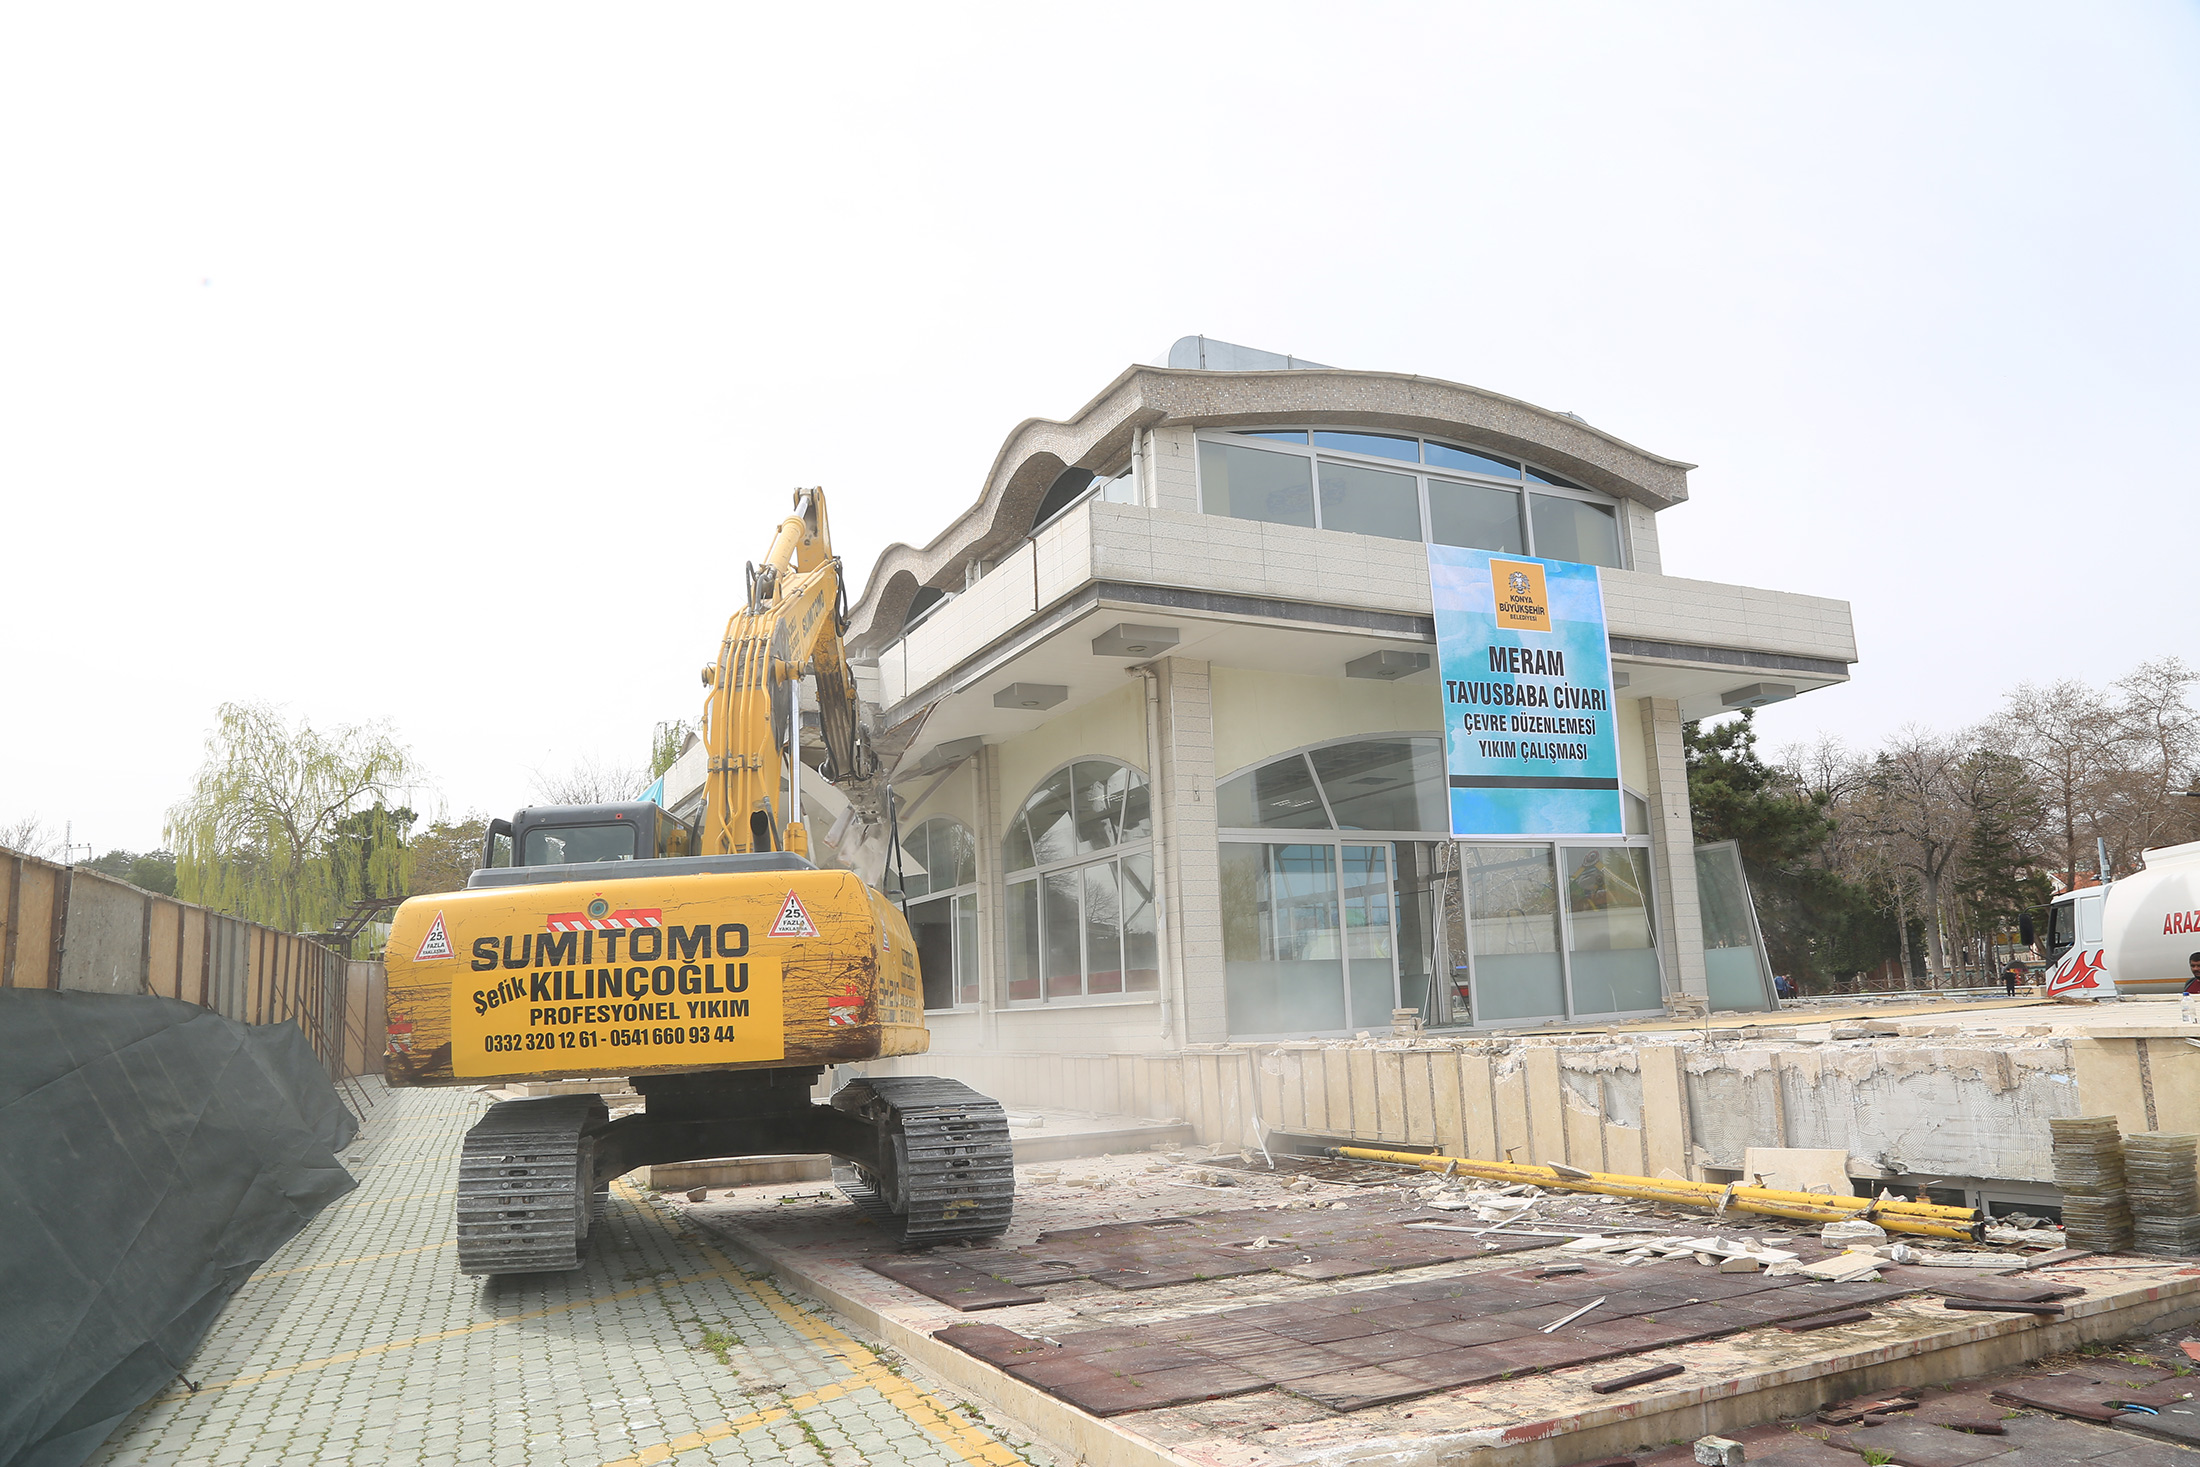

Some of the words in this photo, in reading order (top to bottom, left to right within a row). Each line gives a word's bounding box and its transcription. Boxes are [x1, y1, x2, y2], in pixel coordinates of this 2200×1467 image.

[1499, 602, 1545, 615] BÜYÜKŞEHİR
[1510, 595, 1533, 603] KONYA
[1488, 645, 1565, 676] MERAM
[1446, 680, 1548, 708] TAVUSBABA
[1553, 682, 1607, 711] CİVARI
[1464, 713, 1506, 735] ÇEVRE
[1511, 712, 1596, 735] DÜZENLEMESİ
[1479, 740, 1516, 758] YIKIM
[1520, 742, 1588, 764] ÇALIŞMASI
[471, 923, 749, 971] SUMITOMO
[473, 976, 527, 1017] Şefik
[530, 959, 749, 1002] KILINÇOĞLU
[530, 1002, 680, 1026] PROFESYONEL
[687, 999, 749, 1019] YIKIM
[484, 1034, 522, 1052] 0332
[526, 1032, 555, 1050] 320
[558, 1031, 575, 1048] 12
[579, 1031, 598, 1048] 61
[610, 1029, 649, 1046] 0541
[652, 1027, 685, 1045] 660
[689, 1026, 710, 1043] 93
[714, 1025, 735, 1043] 44
